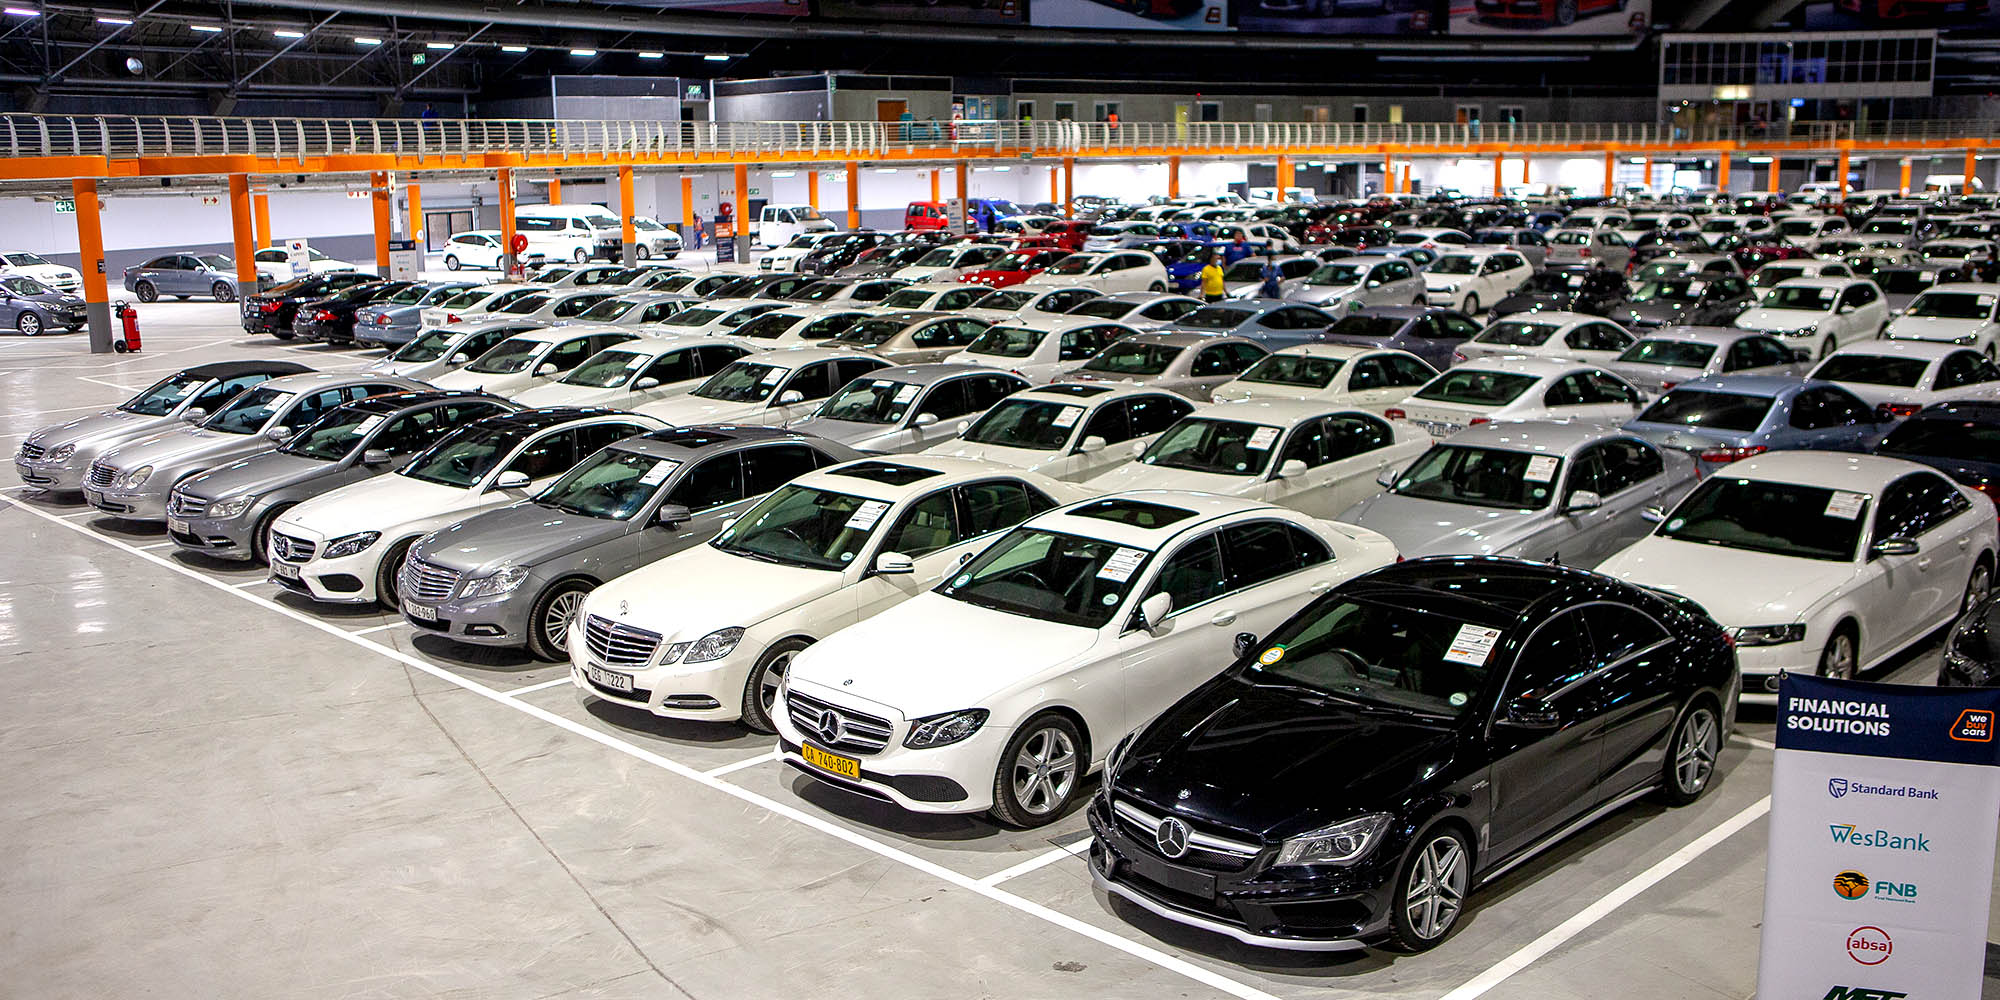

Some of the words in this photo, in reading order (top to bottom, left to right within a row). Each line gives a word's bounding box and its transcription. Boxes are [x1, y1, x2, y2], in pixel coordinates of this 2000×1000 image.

[1788, 697, 1890, 718] FINANCIAL
[1787, 715, 1890, 736] SOLUTIONS
[1966, 720, 1986, 730] buy
[1970, 715, 1988, 723] we
[1962, 728, 1986, 736] cars
[806, 746, 815, 761] CA
[819, 753, 853, 775] 740-802
[1851, 782, 1905, 797] Standard
[1908, 788, 1938, 800] Bank
[1830, 824, 1930, 852] WesBank
[1875, 881, 1917, 897] FNB
[1852, 938, 1887, 952] absa
